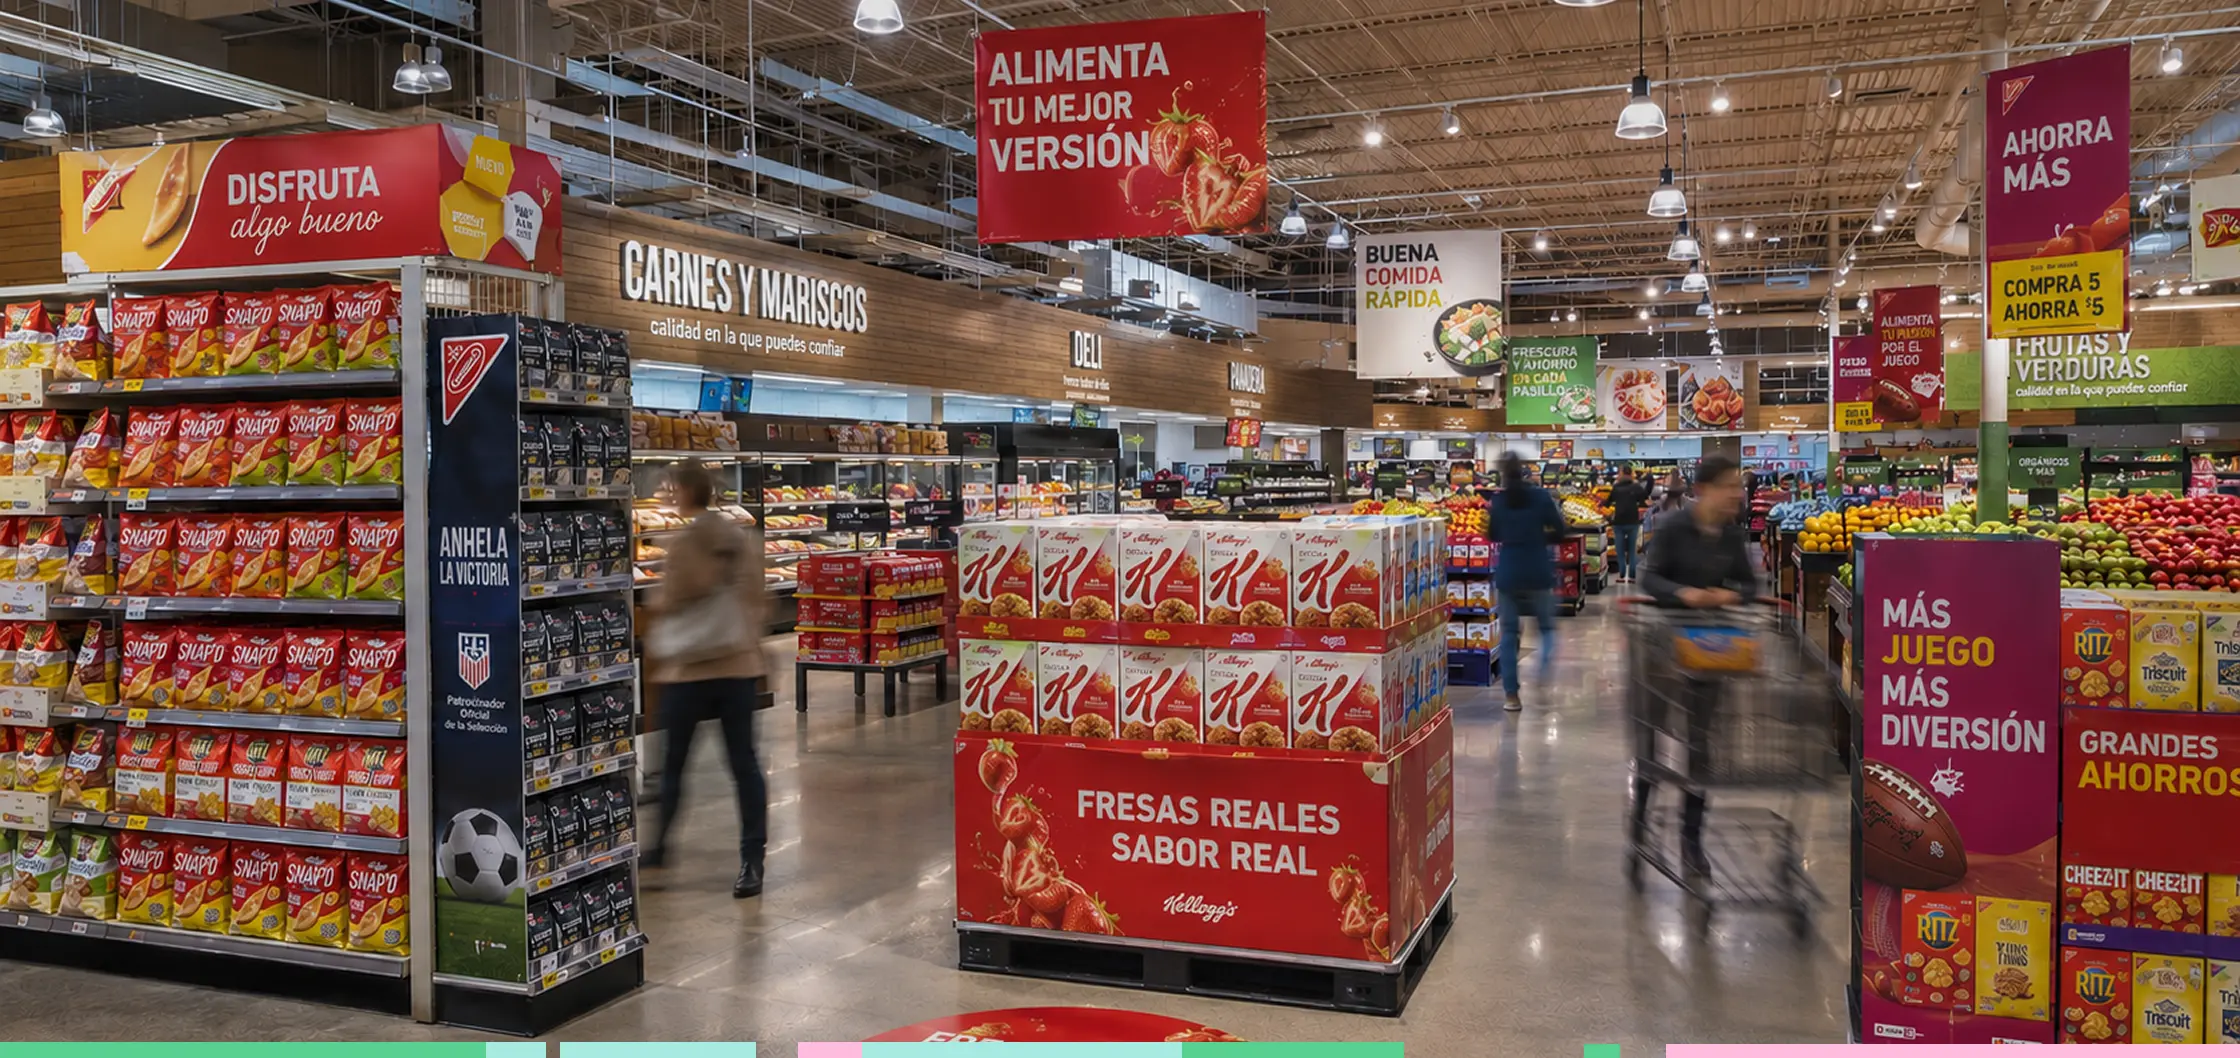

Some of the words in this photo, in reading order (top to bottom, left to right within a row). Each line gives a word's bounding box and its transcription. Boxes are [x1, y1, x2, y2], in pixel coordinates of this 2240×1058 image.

[988, 42, 1170, 87] ALIMENTA
[988, 96, 1024, 126] TU
[1034, 91, 1132, 124] MEJOR
[990, 123, 1150, 172] VERSIÓN
[2002, 116, 2113, 158] AHORRA
[228, 165, 380, 206] DISFRUTA
[2003, 154, 2072, 194] MÁS
[230, 204, 292, 256] algo
[298, 198, 383, 236] bueno
[1366, 243, 1439, 264] BUENA
[623, 240, 732, 312] CARNES
[737, 263, 755, 315] Y
[760, 268, 868, 333] MARISCOS
[1366, 266, 1443, 286] COMIDA
[2004, 272, 2082, 298] COMPRA
[2088, 272, 2101, 292] 5
[1366, 286, 1442, 309] RÁPIDA
[2004, 299, 2080, 322] AHORRA
[2085, 296, 2104, 316] $5
[650, 318, 700, 341] calidad
[705, 326, 720, 342] en
[725, 324, 736, 344] la
[739, 331, 762, 351] que
[766, 334, 806, 354] puedes
[809, 339, 846, 357] confiar
[1072, 330, 1102, 370] DELI
[1512, 346, 1577, 358] FRESCURA
[1882, 342, 1904, 353] POR
[1908, 340, 1922, 352] EL
[2016, 333, 2110, 356] FRUTAS
[2118, 330, 2133, 355] Y
[1513, 360, 1521, 370] Y
[1882, 354, 1920, 366] JUEGO
[2015, 354, 2150, 382] VERDURAS
[1512, 386, 1566, 397] PASILLO
[2016, 384, 2053, 397] calidad
[2055, 386, 2068, 396] en
[2070, 384, 2080, 396] la
[2084, 387, 2104, 398] que
[2148, 382, 2188, 394] confiar
[440, 526, 508, 559] ANHELA
[440, 561, 454, 584] LA
[456, 561, 510, 586] VICTORIA
[964, 544, 1006, 600] K
[1043, 546, 1088, 602] K
[1125, 548, 1172, 606] K
[1210, 549, 1258, 607] K
[1298, 549, 1350, 609] K
[1882, 590, 1950, 628] MÁS
[1882, 634, 1994, 667] JUEGO
[2074, 632, 2113, 656] RITZ
[965, 660, 1008, 715] K
[1882, 668, 1950, 708] MÁS
[2142, 666, 2188, 682] Triscuit
[446, 694, 506, 709] Patrocinador
[1044, 664, 1088, 718] K
[1125, 668, 1172, 722] K
[1210, 672, 1258, 727] K
[1298, 674, 1348, 732] K
[444, 720, 455, 730] de
[457, 720, 465, 730] la
[460, 708, 490, 720] Oficial
[1882, 710, 2046, 754] DIVERSIÓN
[2080, 730, 2218, 760] GRANDES
[1078, 789, 1200, 826] FRESAS
[1210, 798, 1340, 835] REALES
[1112, 832, 1220, 868] SABOR
[1231, 841, 1318, 876] REAL
[1163, 892, 1238, 922] Kellogg's
[1917, 914, 1960, 942] RITZ
[2076, 970, 2116, 998] RITZ
[2145, 1010, 2192, 1030] Triscuit
